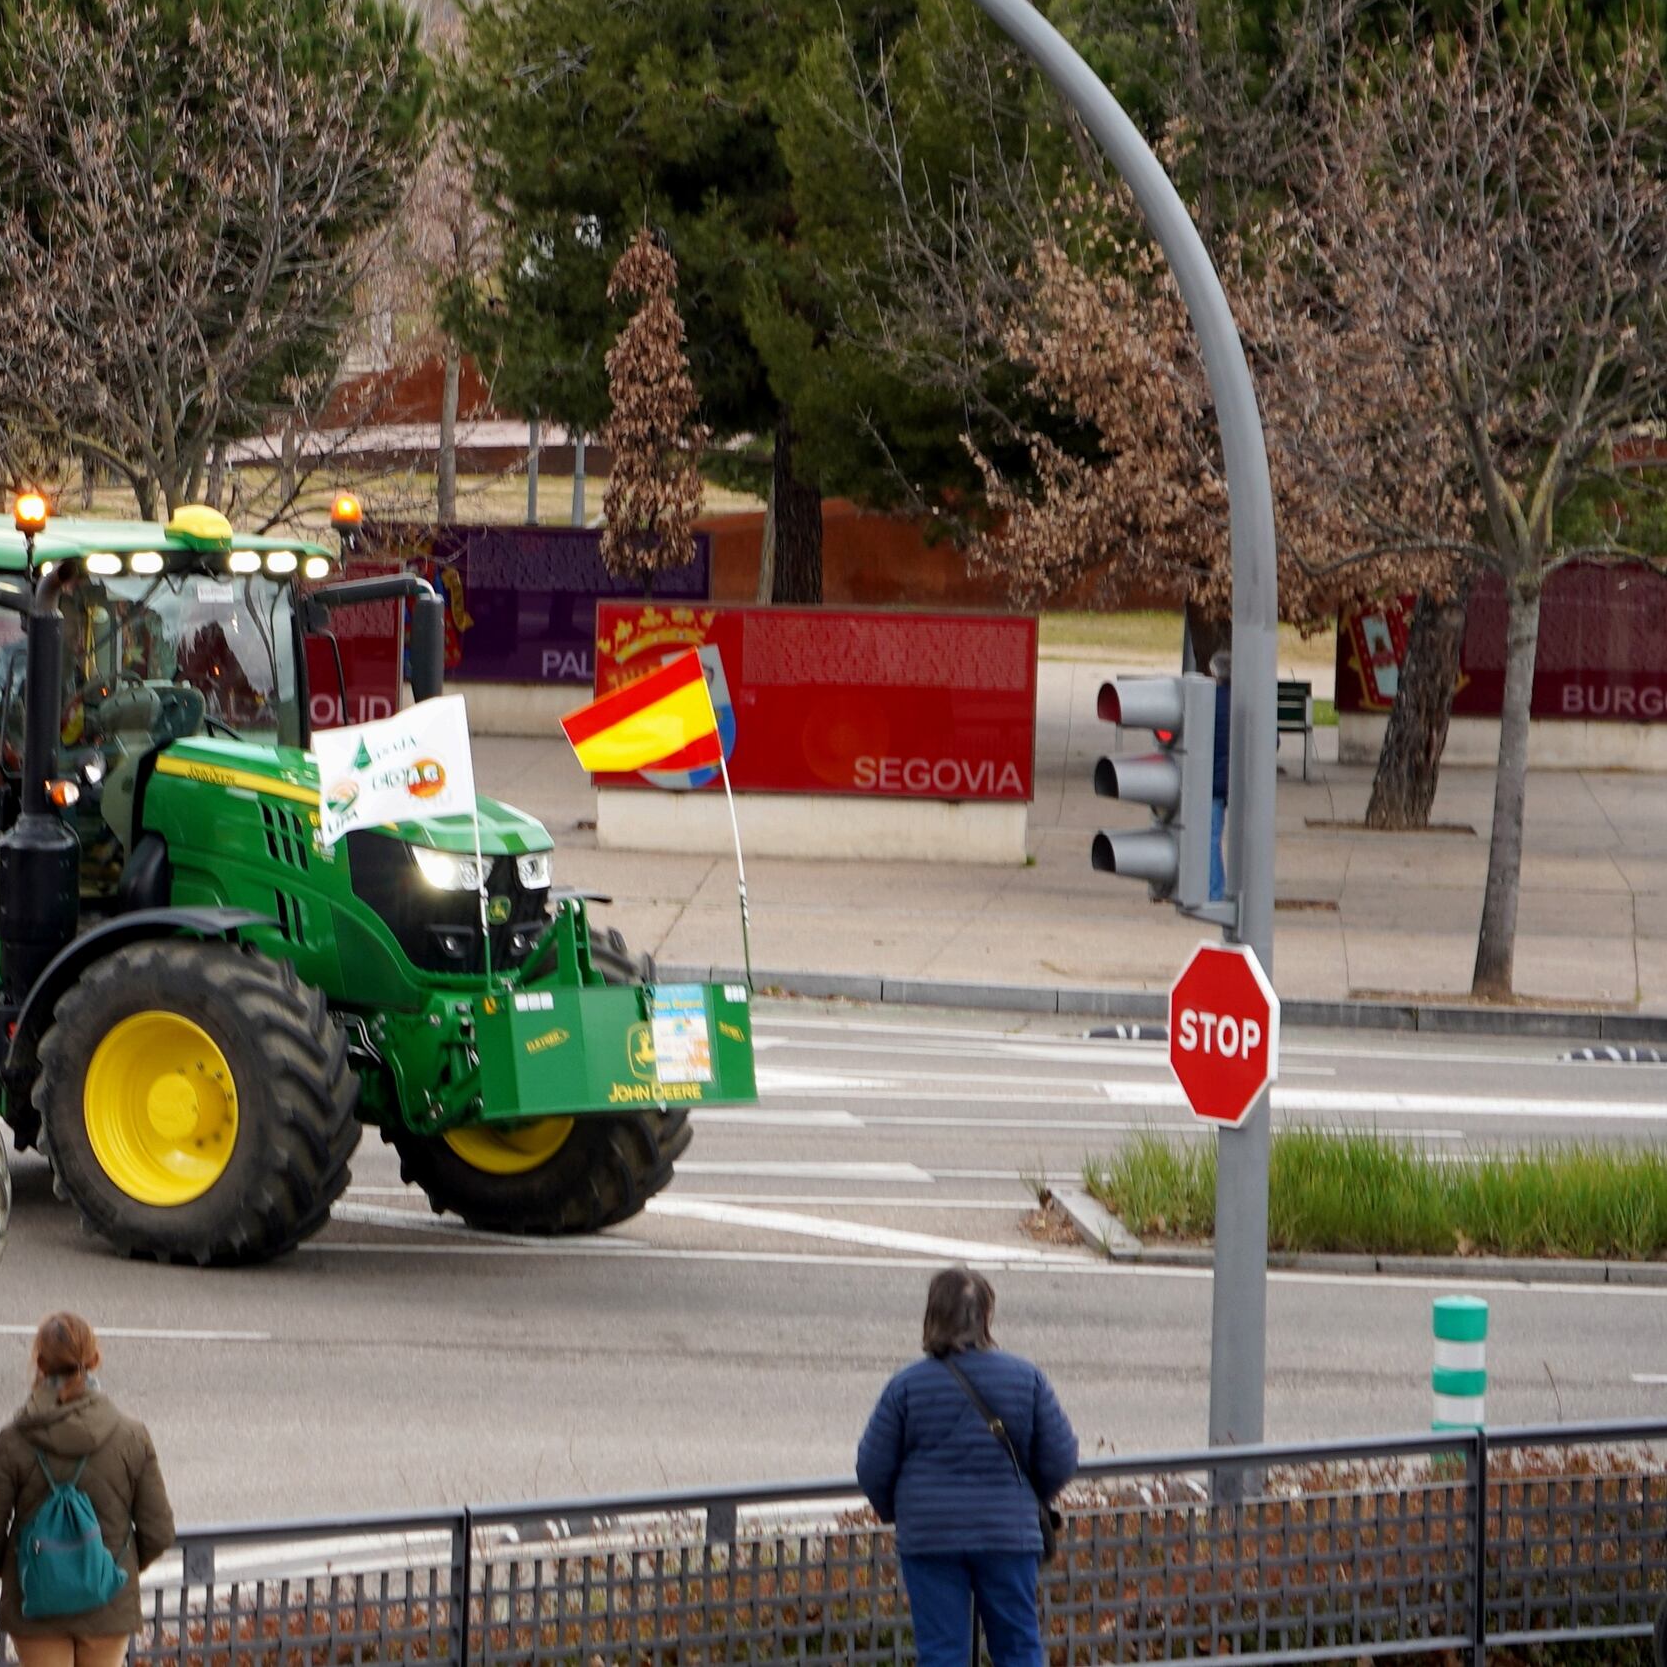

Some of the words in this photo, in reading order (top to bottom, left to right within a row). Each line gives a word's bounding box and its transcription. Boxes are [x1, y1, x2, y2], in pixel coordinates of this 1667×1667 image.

[542, 650, 594, 678] PAL
[1562, 684, 1667, 715] BURG
[853, 756, 1024, 795] SEGOVIA
[1178, 1008, 1261, 1061] STOP
[609, 1082, 650, 1103] JOHN
